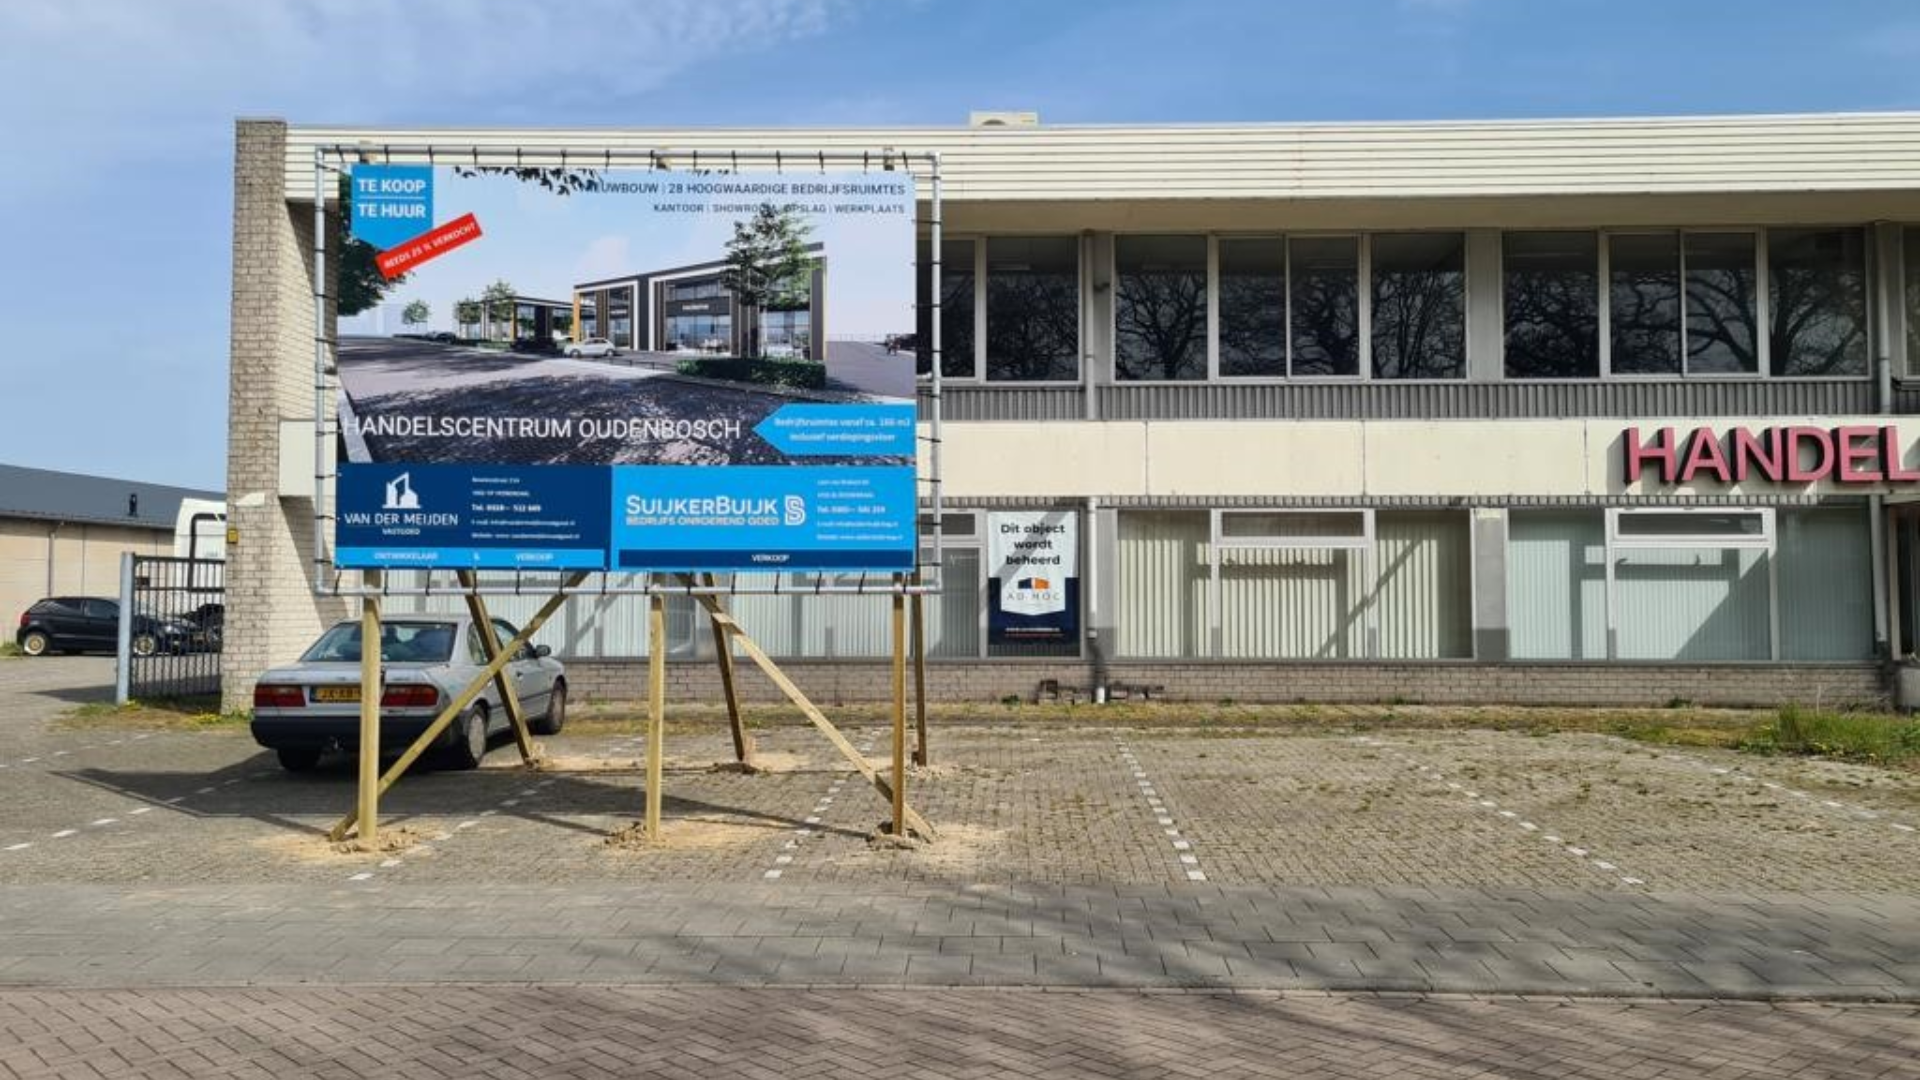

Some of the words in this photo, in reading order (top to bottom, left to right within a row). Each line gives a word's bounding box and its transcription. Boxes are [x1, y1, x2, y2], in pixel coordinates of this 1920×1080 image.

[357, 179, 378, 193] TE
[381, 180, 426, 193] KOOP
[669, 182, 683, 194] 28
[687, 183, 789, 195] HOOGWAARDIGE
[791, 183, 906, 196] BEDRIJFSRUIMTES
[357, 203, 378, 217] TE
[381, 203, 426, 218] HUUR
[653, 203, 703, 213] KANTOOR
[835, 204, 905, 215] WERKPLAATS
[343, 416, 572, 438] HANDELSCENTRUM
[578, 418, 741, 439] OUDENBOSCH
[344, 513, 370, 524] VAN
[374, 513, 400, 525] DER
[403, 513, 459, 526] MEIJDEN
[626, 516, 676, 526] BEDRIJFS
[677, 516, 746, 526] ONROEREND
[748, 516, 779, 526] GOED
[1001, 524, 1020, 533] Dit
[1024, 524, 1065, 535] object
[1014, 540, 1052, 550] wordt
[752, 554, 789, 563] VERKOOP
[1006, 555, 1061, 565] beheerd
